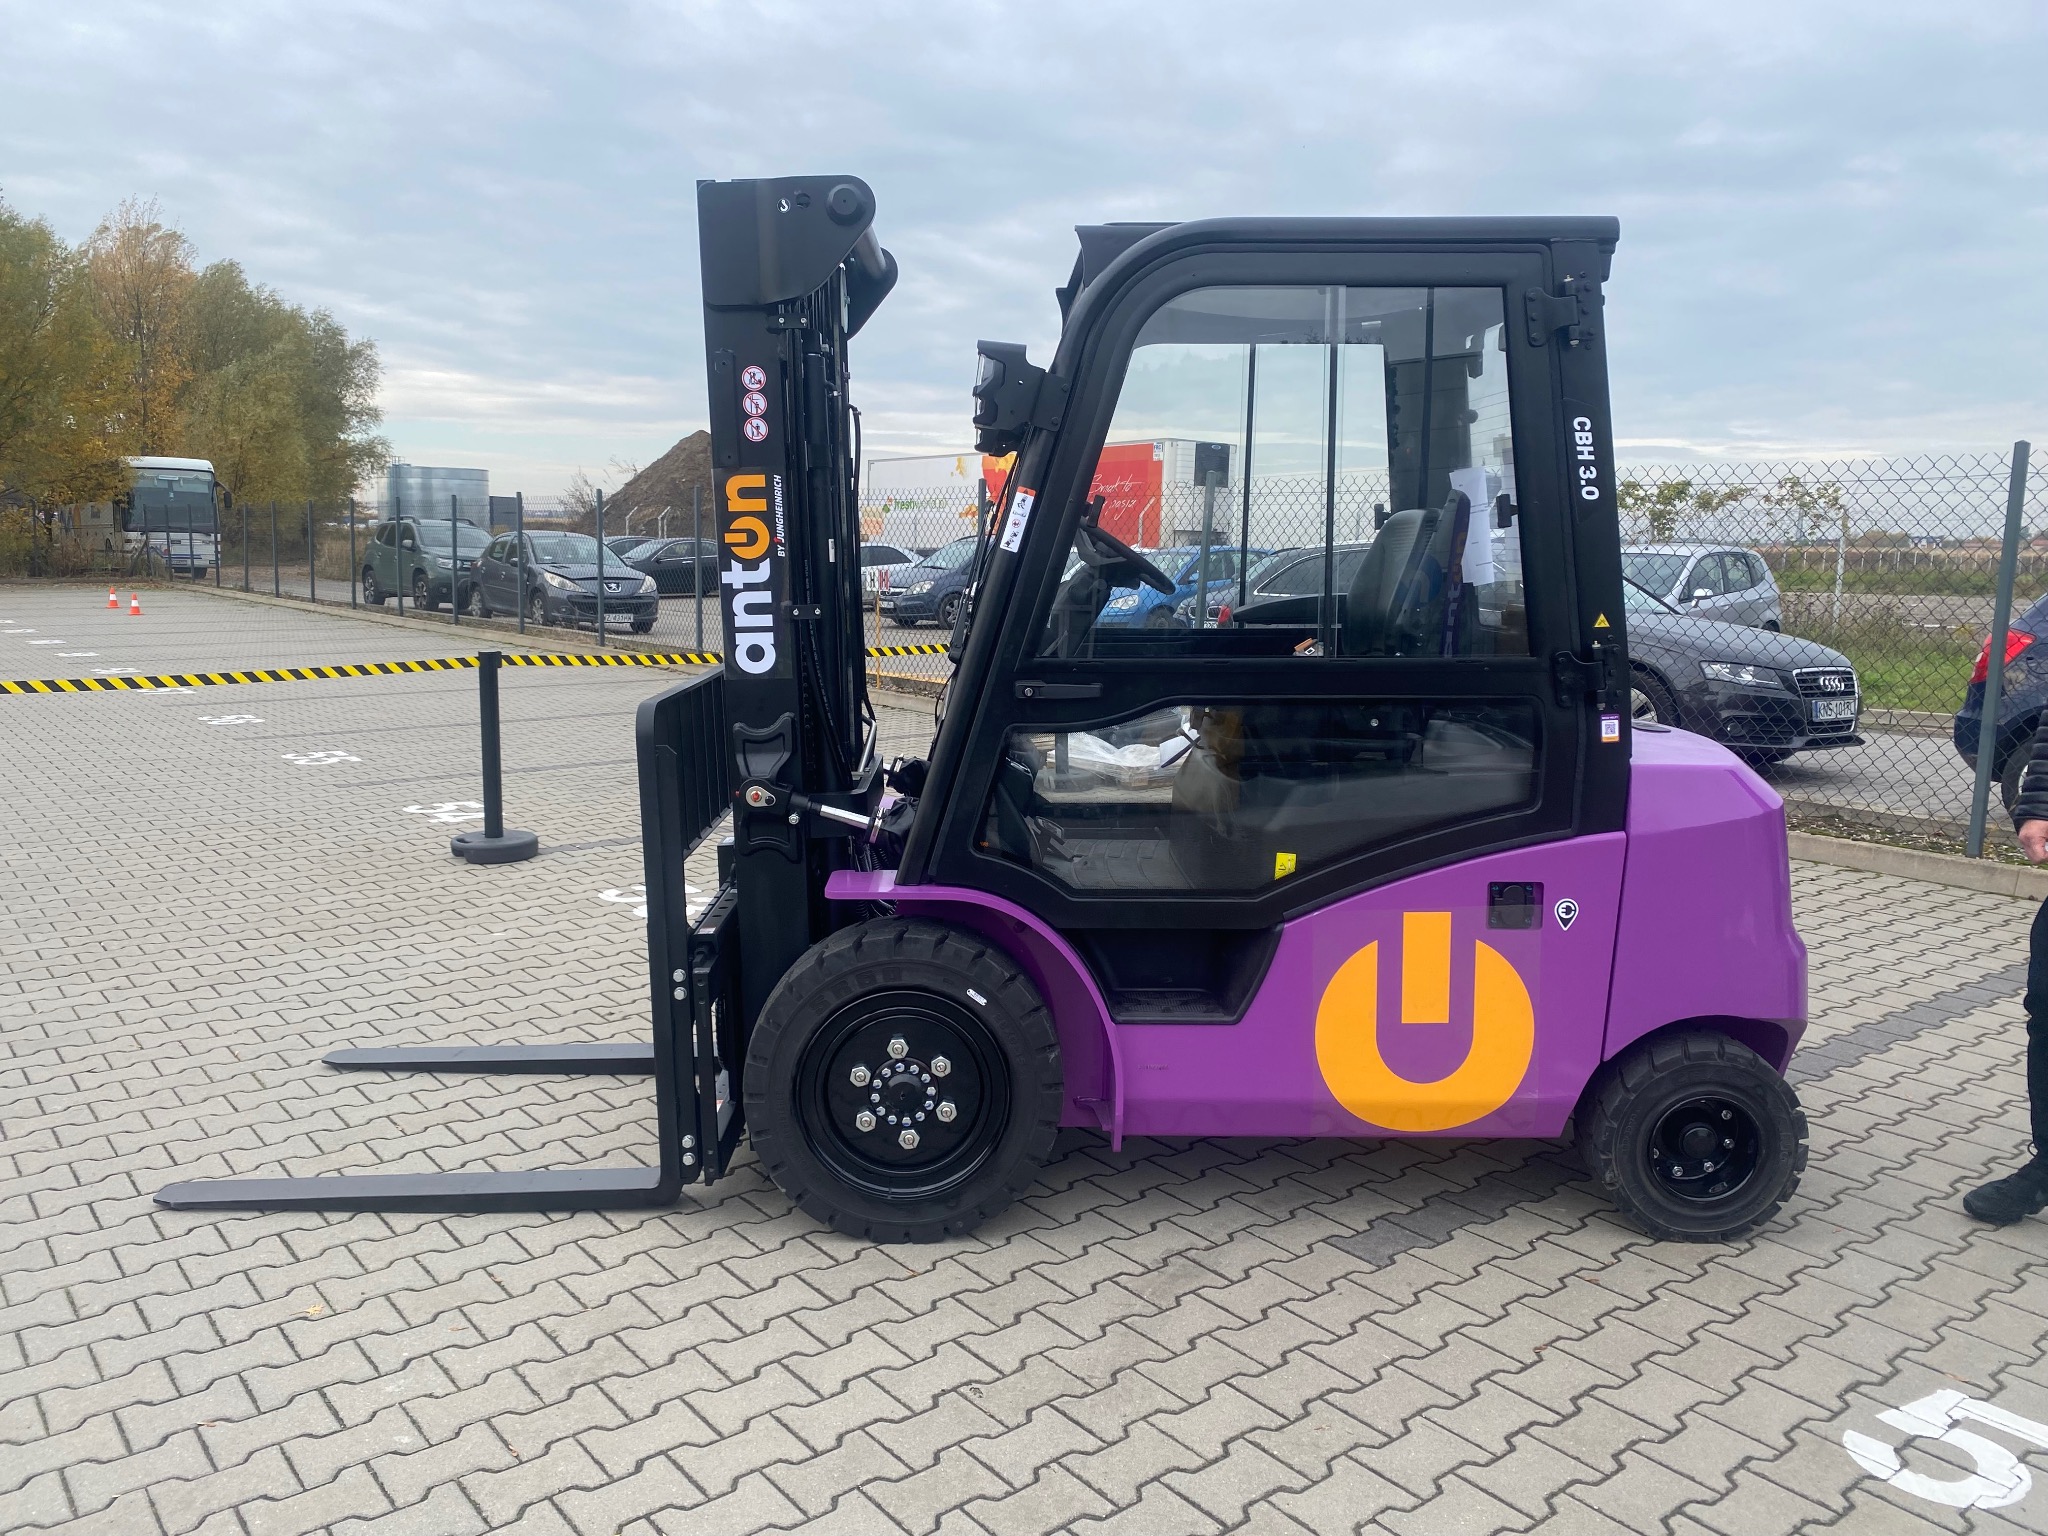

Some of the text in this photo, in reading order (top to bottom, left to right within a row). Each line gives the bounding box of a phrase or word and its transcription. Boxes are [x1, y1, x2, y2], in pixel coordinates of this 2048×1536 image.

[1573, 416, 1600, 500] CBH 3.0
[773, 474, 786, 557] BY JUNGHEINRICH
[721, 474, 776, 674] anton
[281, 750, 363, 765] 55
[402, 801, 508, 823] 54
